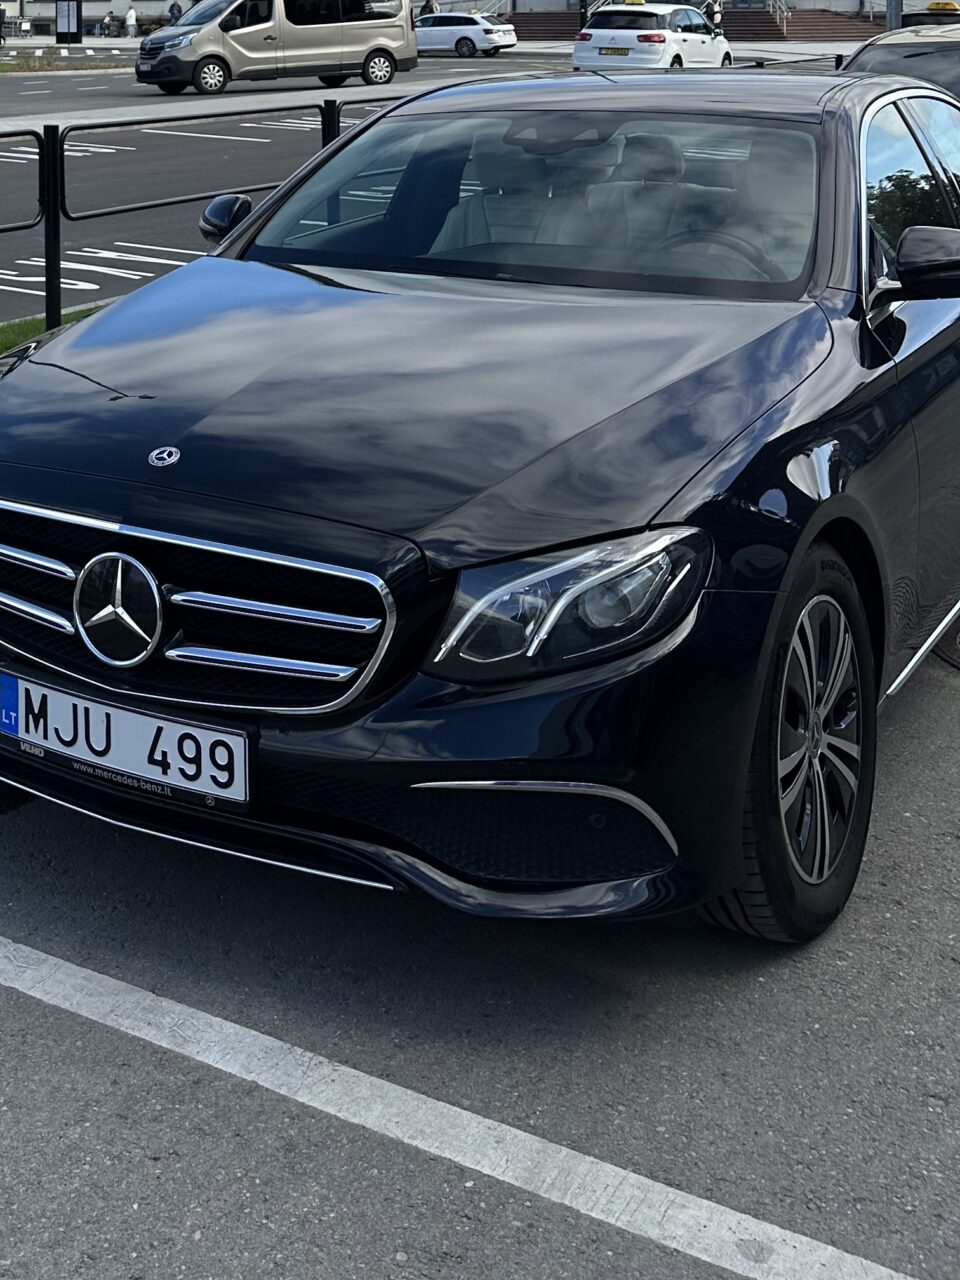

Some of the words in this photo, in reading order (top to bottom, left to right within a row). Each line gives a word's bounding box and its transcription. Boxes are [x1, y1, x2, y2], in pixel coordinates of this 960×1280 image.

[1, 708, 17, 726] LT
[23, 686, 112, 757] MJU
[146, 724, 235, 790] 499
[71, 760, 173, 797] www.mercedes-benz.lt
